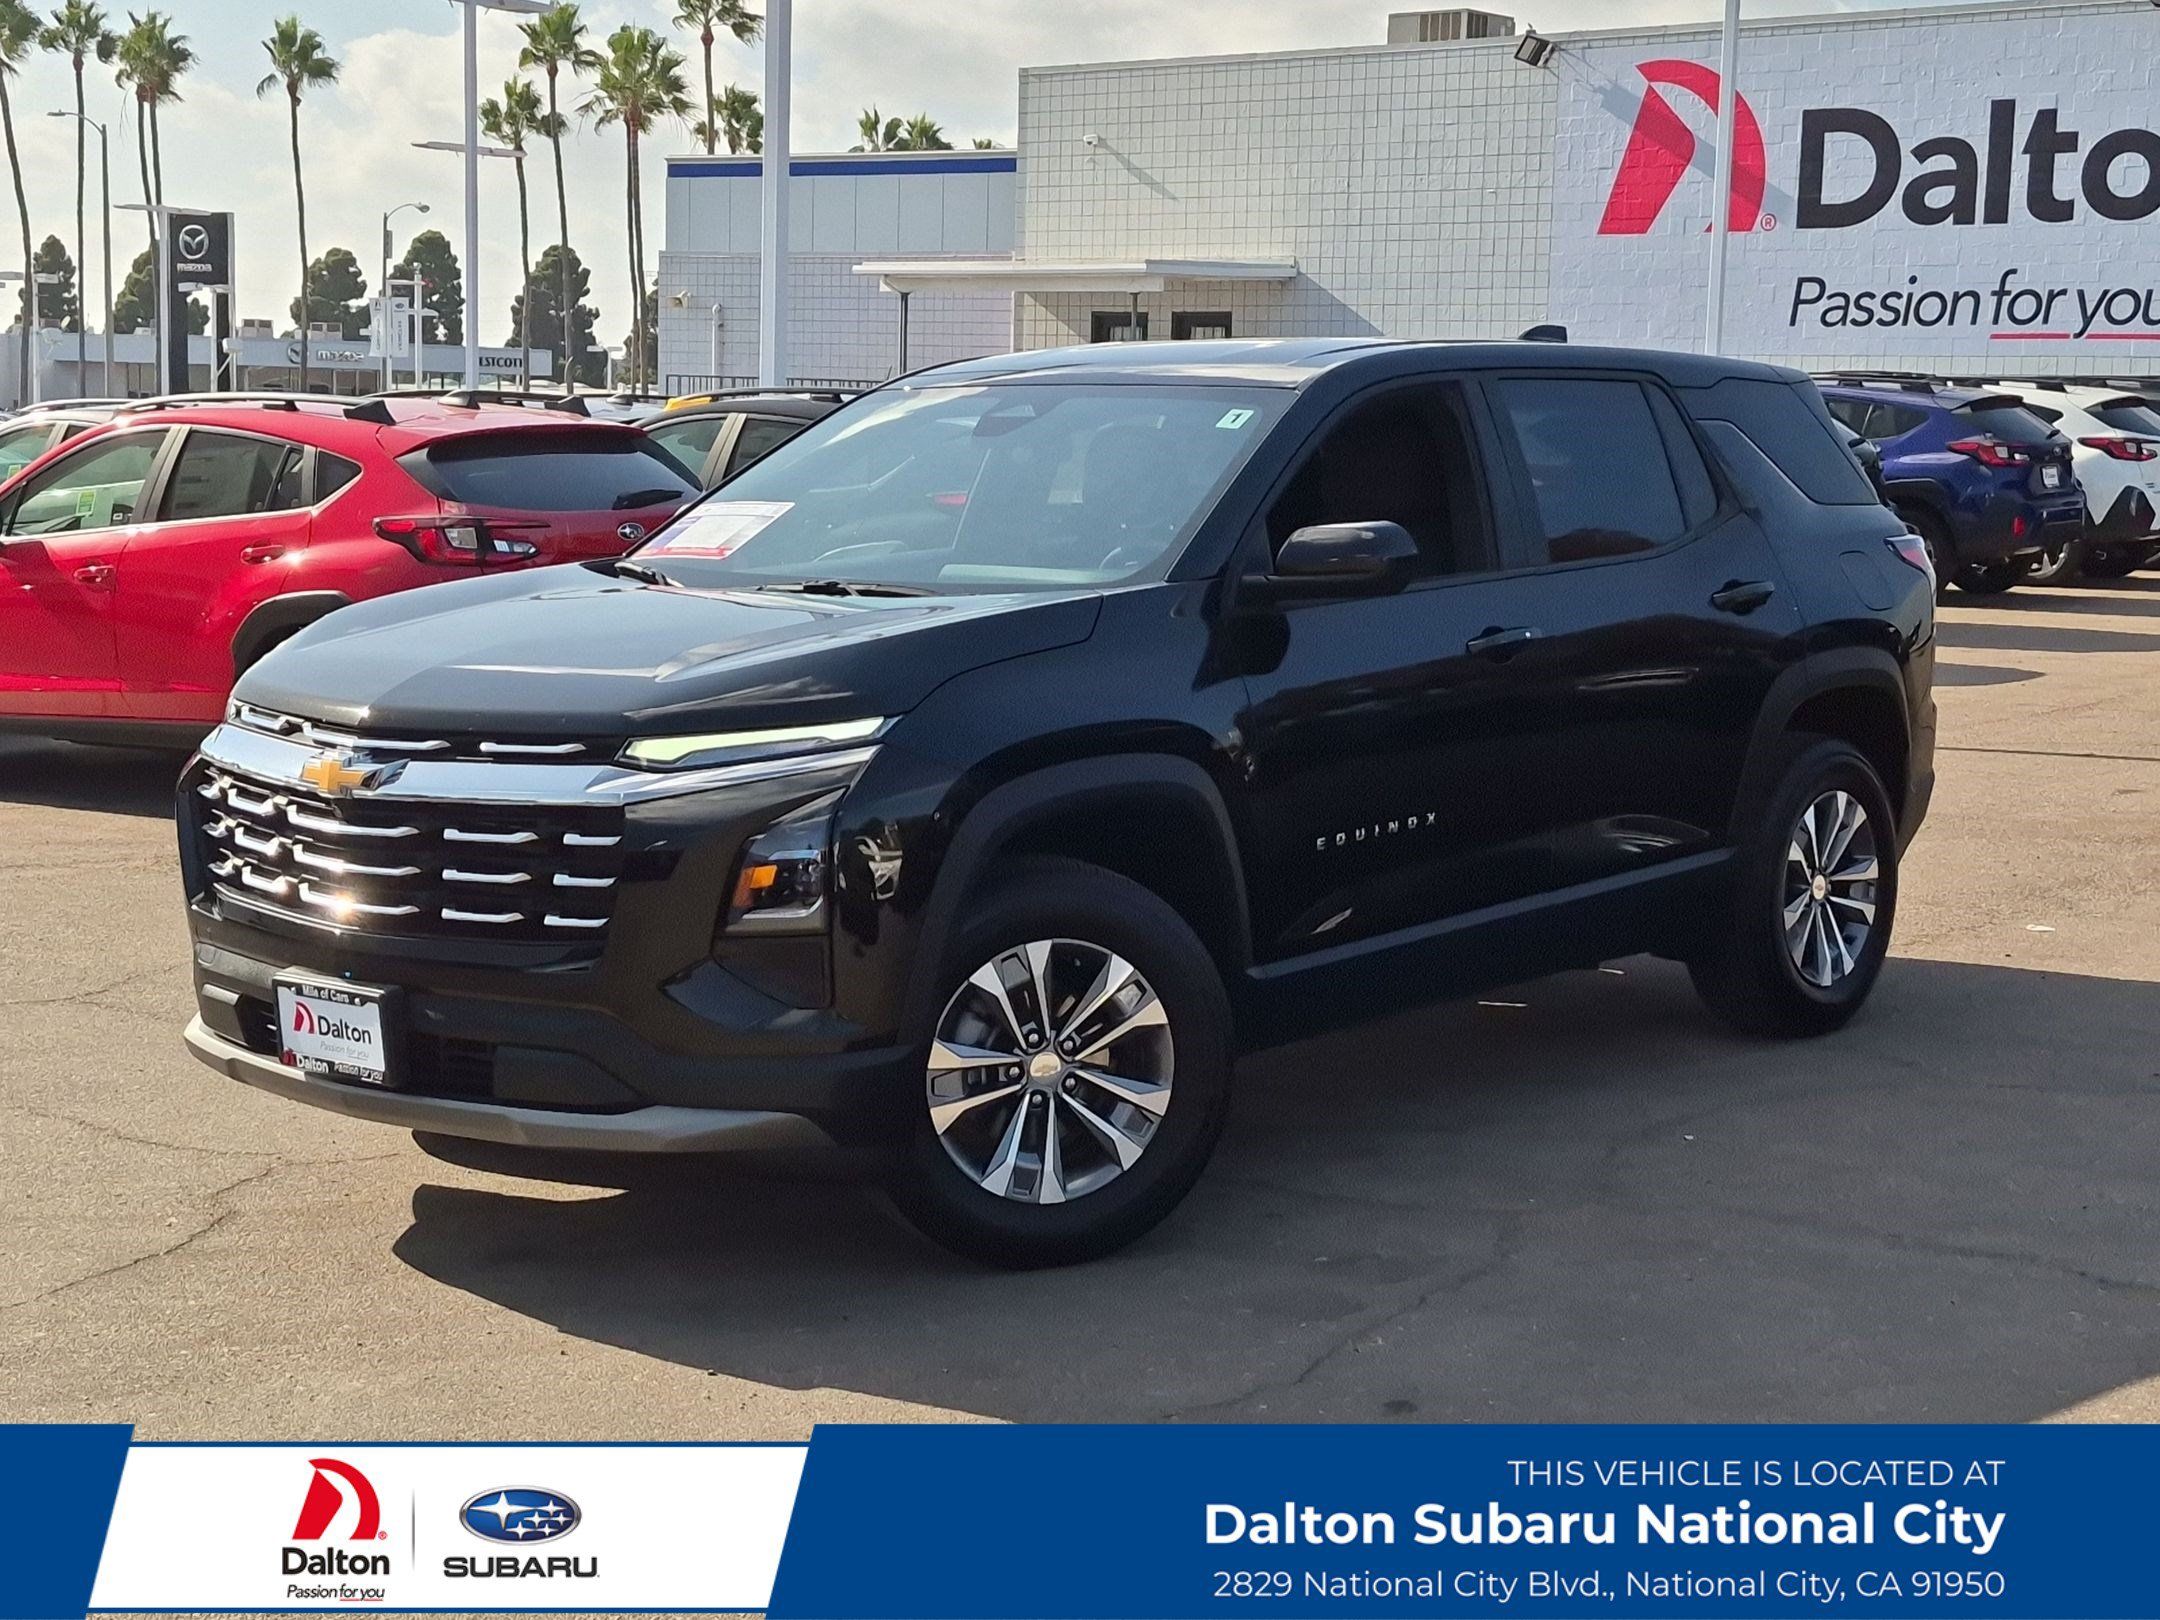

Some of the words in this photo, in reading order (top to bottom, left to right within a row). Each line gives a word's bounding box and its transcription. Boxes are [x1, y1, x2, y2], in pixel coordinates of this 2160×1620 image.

[1789, 275, 1981, 328] Passion
[1990, 268, 2068, 326] for
[1231, 412, 1244, 424] 1
[1316, 811, 1437, 851] EQUINOX
[317, 1014, 372, 1045] Dalton
[321, 1040, 346, 1053] Passion
[295, 1052, 330, 1074] Dalton
